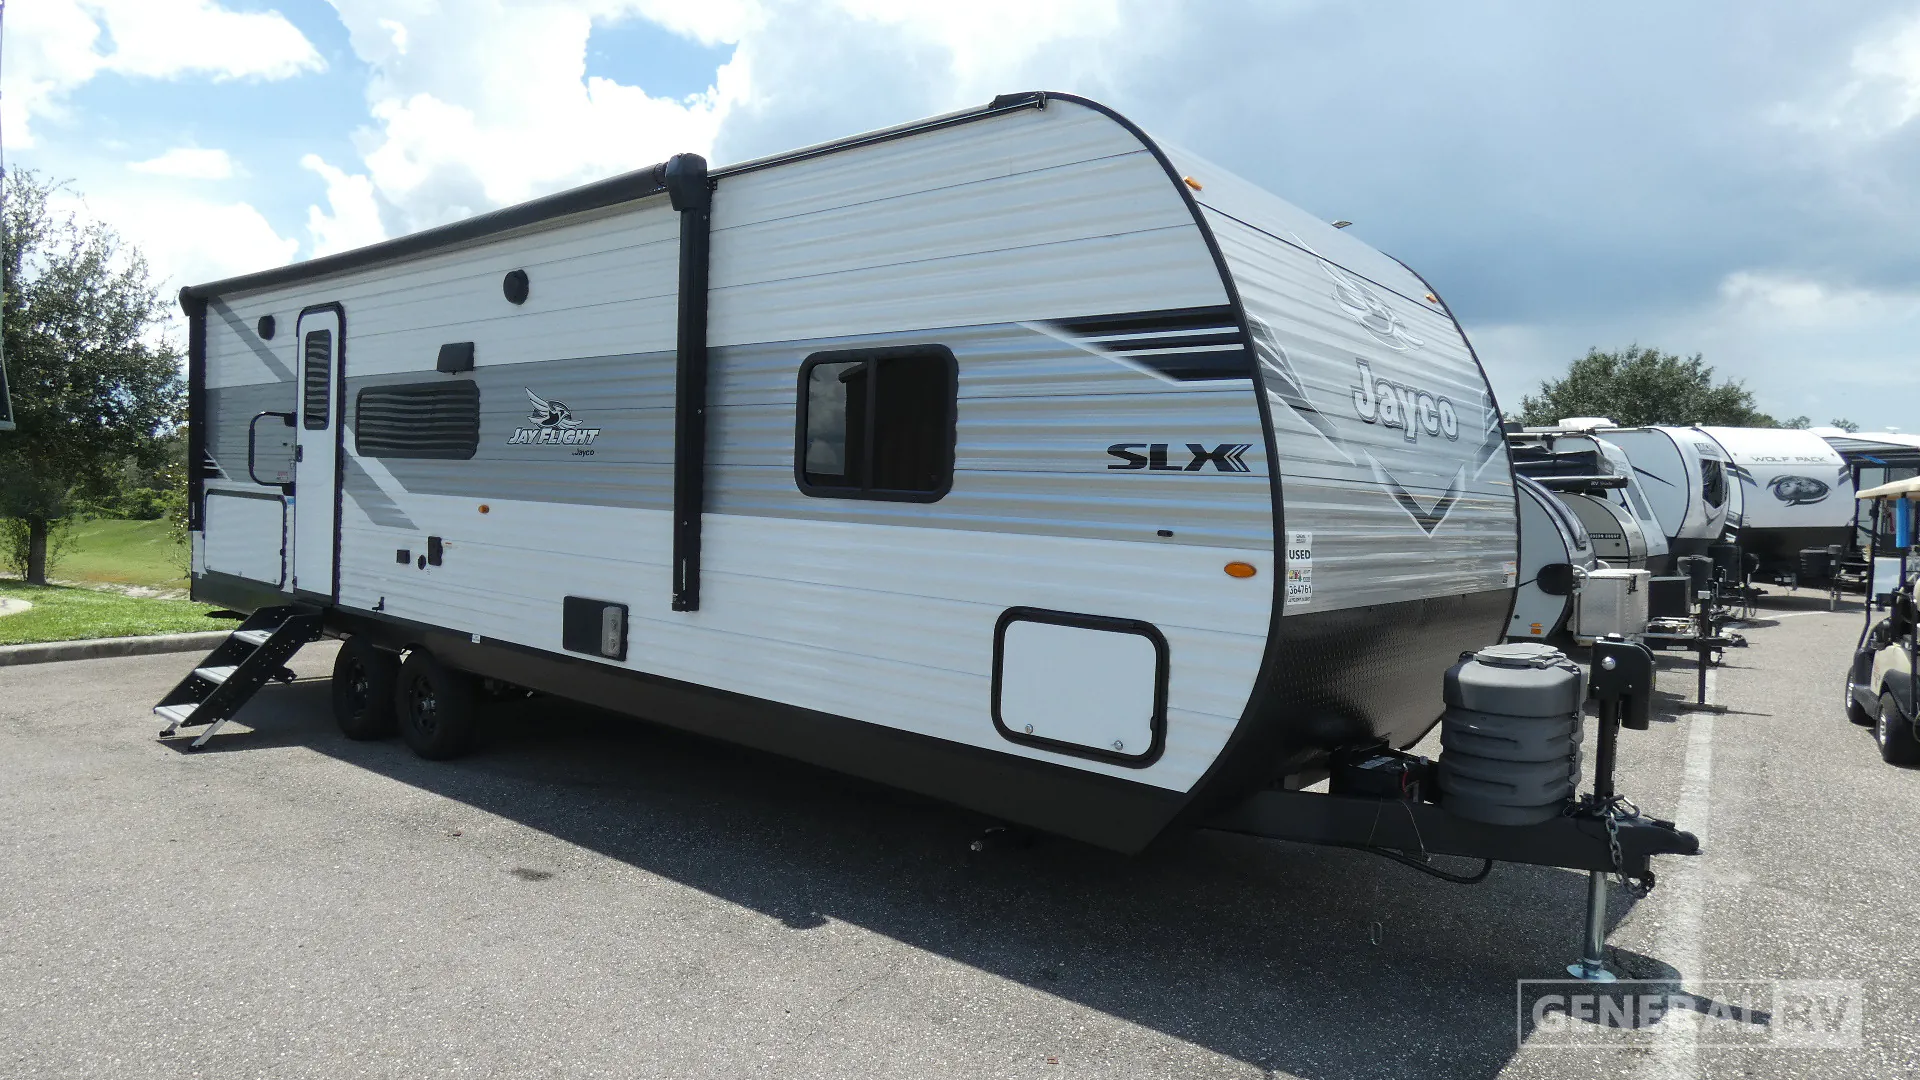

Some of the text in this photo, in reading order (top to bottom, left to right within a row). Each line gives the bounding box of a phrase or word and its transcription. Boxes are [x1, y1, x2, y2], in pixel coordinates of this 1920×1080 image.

[1350, 357, 1459, 444] Jayco
[507, 427, 602, 446] JAY FLIGHT
[1107, 443, 1253, 473] SLX
[1289, 549, 1311, 560] USED
